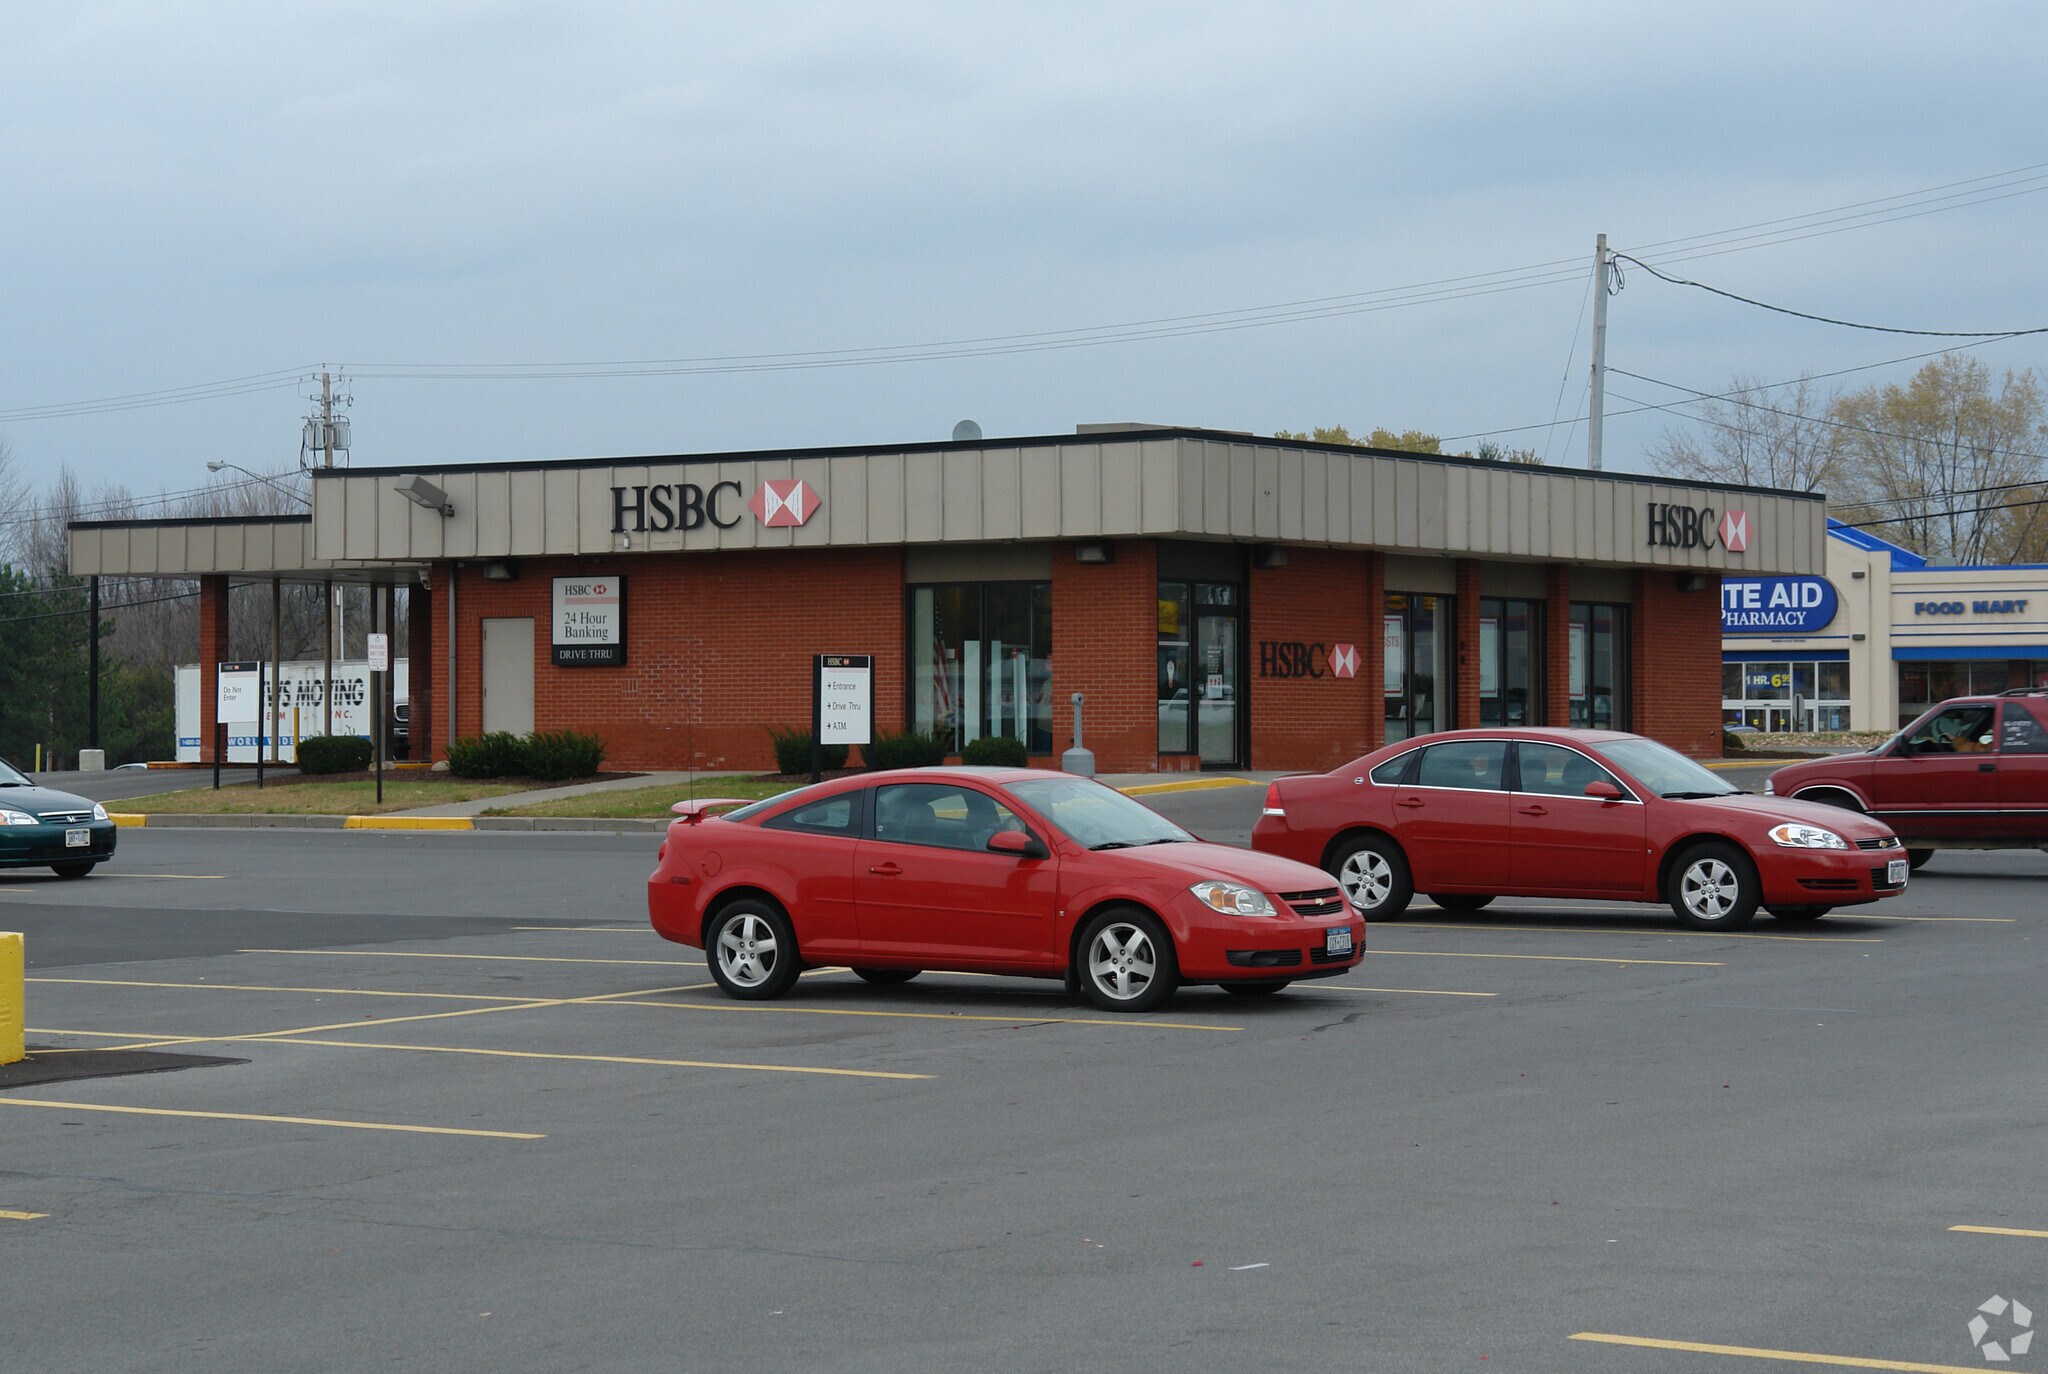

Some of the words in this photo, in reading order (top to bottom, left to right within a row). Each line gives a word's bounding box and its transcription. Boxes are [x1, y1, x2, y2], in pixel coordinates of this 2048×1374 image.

[610, 480, 742, 533] HSBC
[1647, 502, 1716, 551] HSBC
[564, 584, 592, 596] HSBC
[1768, 582, 1823, 608] AID
[1914, 601, 1965, 615] FOOD
[1972, 599, 2028, 614] MART
[564, 612, 577, 625] 24
[580, 612, 608, 625] Hour
[565, 625, 609, 641] Banking
[559, 650, 587, 660] DRIVE
[588, 649, 613, 660] THRU
[1259, 641, 1326, 679] HSBC
[832, 681, 857, 691] Entrance
[1745, 675, 1751, 685] 1
[223, 686, 231, 694] Do
[232, 686, 242, 694] Not
[832, 701, 847, 711] Drive
[848, 701, 862, 711] Thru
